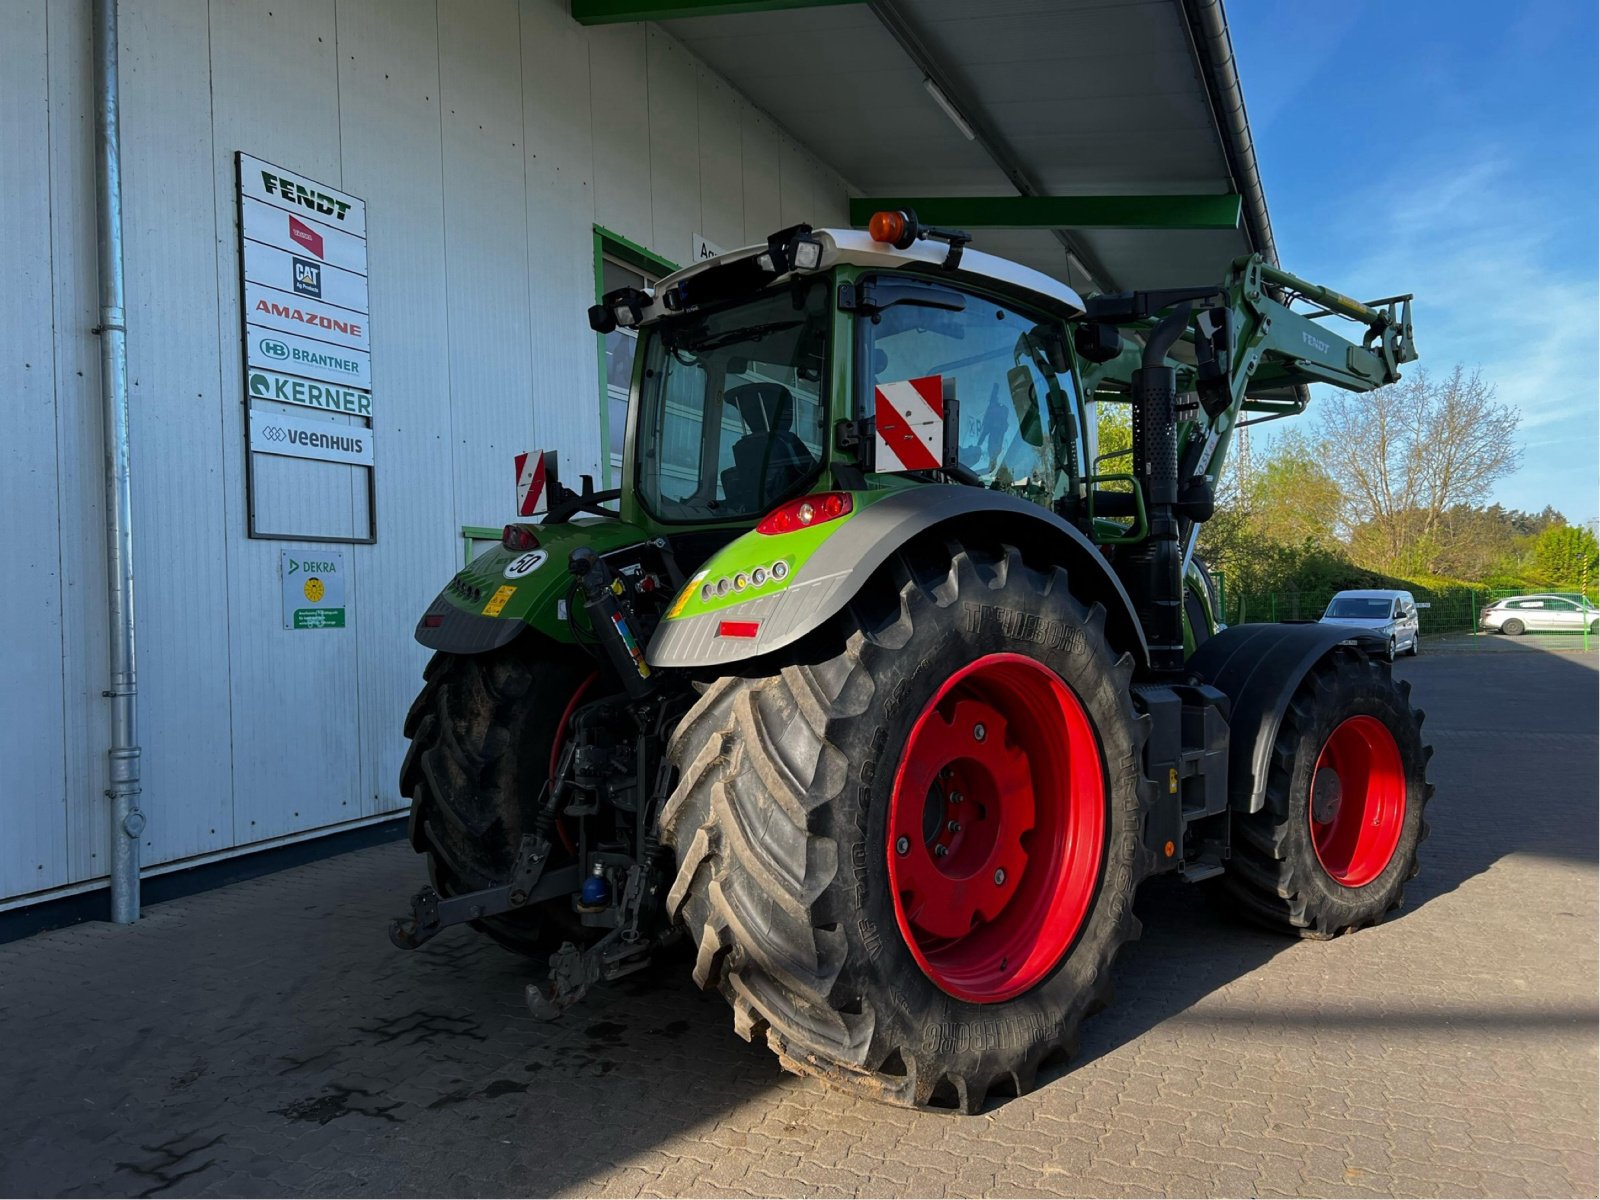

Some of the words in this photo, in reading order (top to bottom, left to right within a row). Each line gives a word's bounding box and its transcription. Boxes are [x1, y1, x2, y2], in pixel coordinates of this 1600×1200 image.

[261, 170, 351, 221] FENDT
[295, 263, 319, 285] CAT
[256, 300, 362, 337] AMAZONE
[1302, 331, 1331, 354] FENDT
[292, 347, 360, 373] BRANTNER
[274, 377, 372, 415] KERNER
[303, 561, 336, 573] DEKRA
[509, 553, 541, 573] 50
[962, 600, 1088, 656] TRELLEBORG
